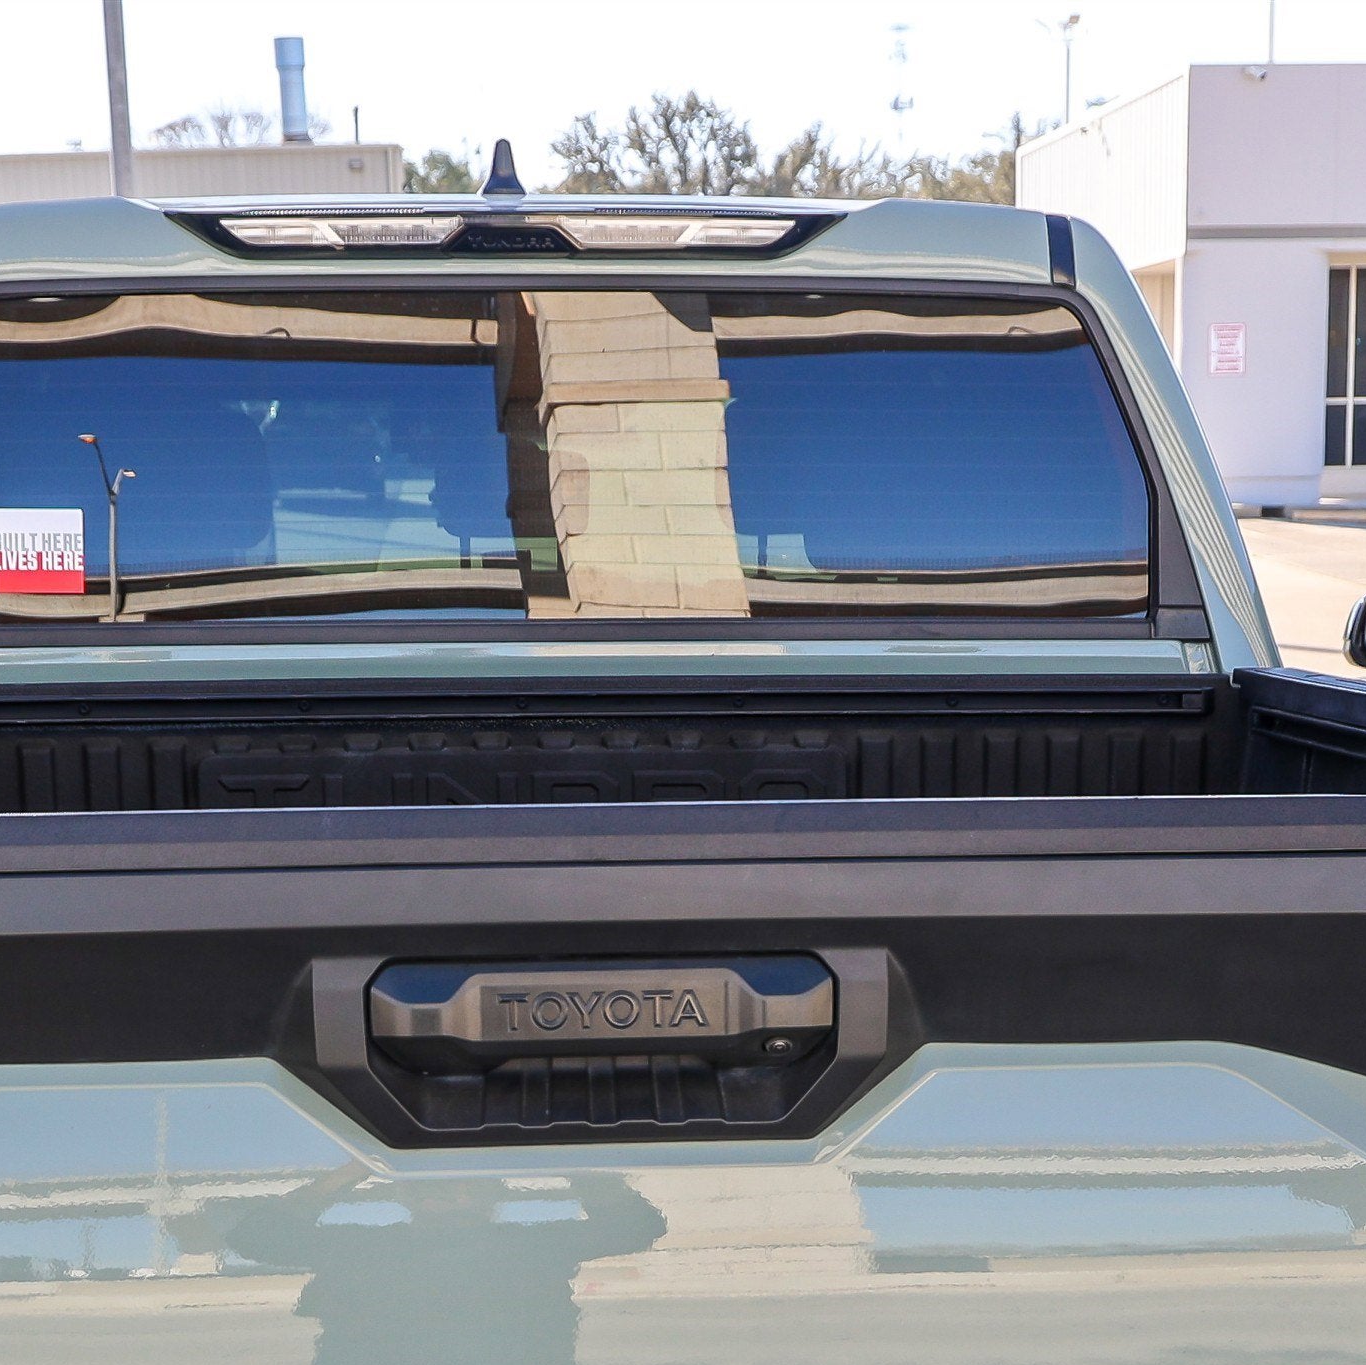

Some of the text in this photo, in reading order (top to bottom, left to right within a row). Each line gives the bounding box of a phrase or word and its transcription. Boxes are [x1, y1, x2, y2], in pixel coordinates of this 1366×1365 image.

[468, 235, 555, 249] TUNDRA
[42, 533, 82, 551] HERE
[42, 551, 84, 570] HERE
[496, 988, 710, 1032] TOYOTA
